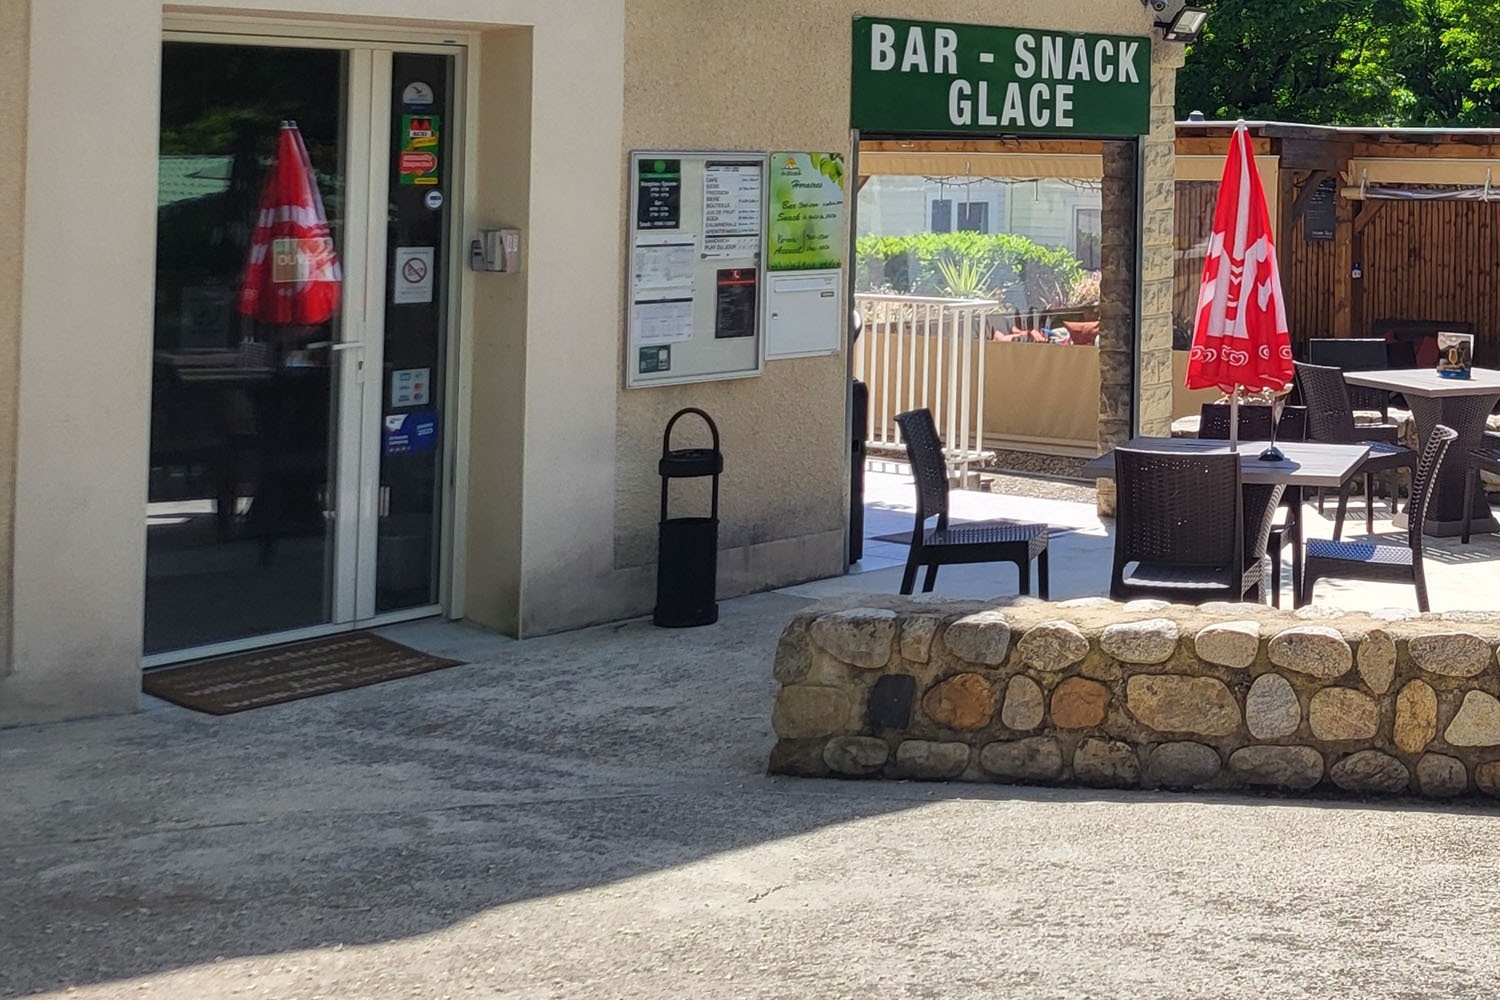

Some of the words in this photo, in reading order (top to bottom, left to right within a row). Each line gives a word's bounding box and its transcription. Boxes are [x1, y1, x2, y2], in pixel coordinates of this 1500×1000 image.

[870, 23, 958, 75] BAR
[1014, 33, 1140, 84] SNACK
[949, 79, 1075, 128] GLACE
